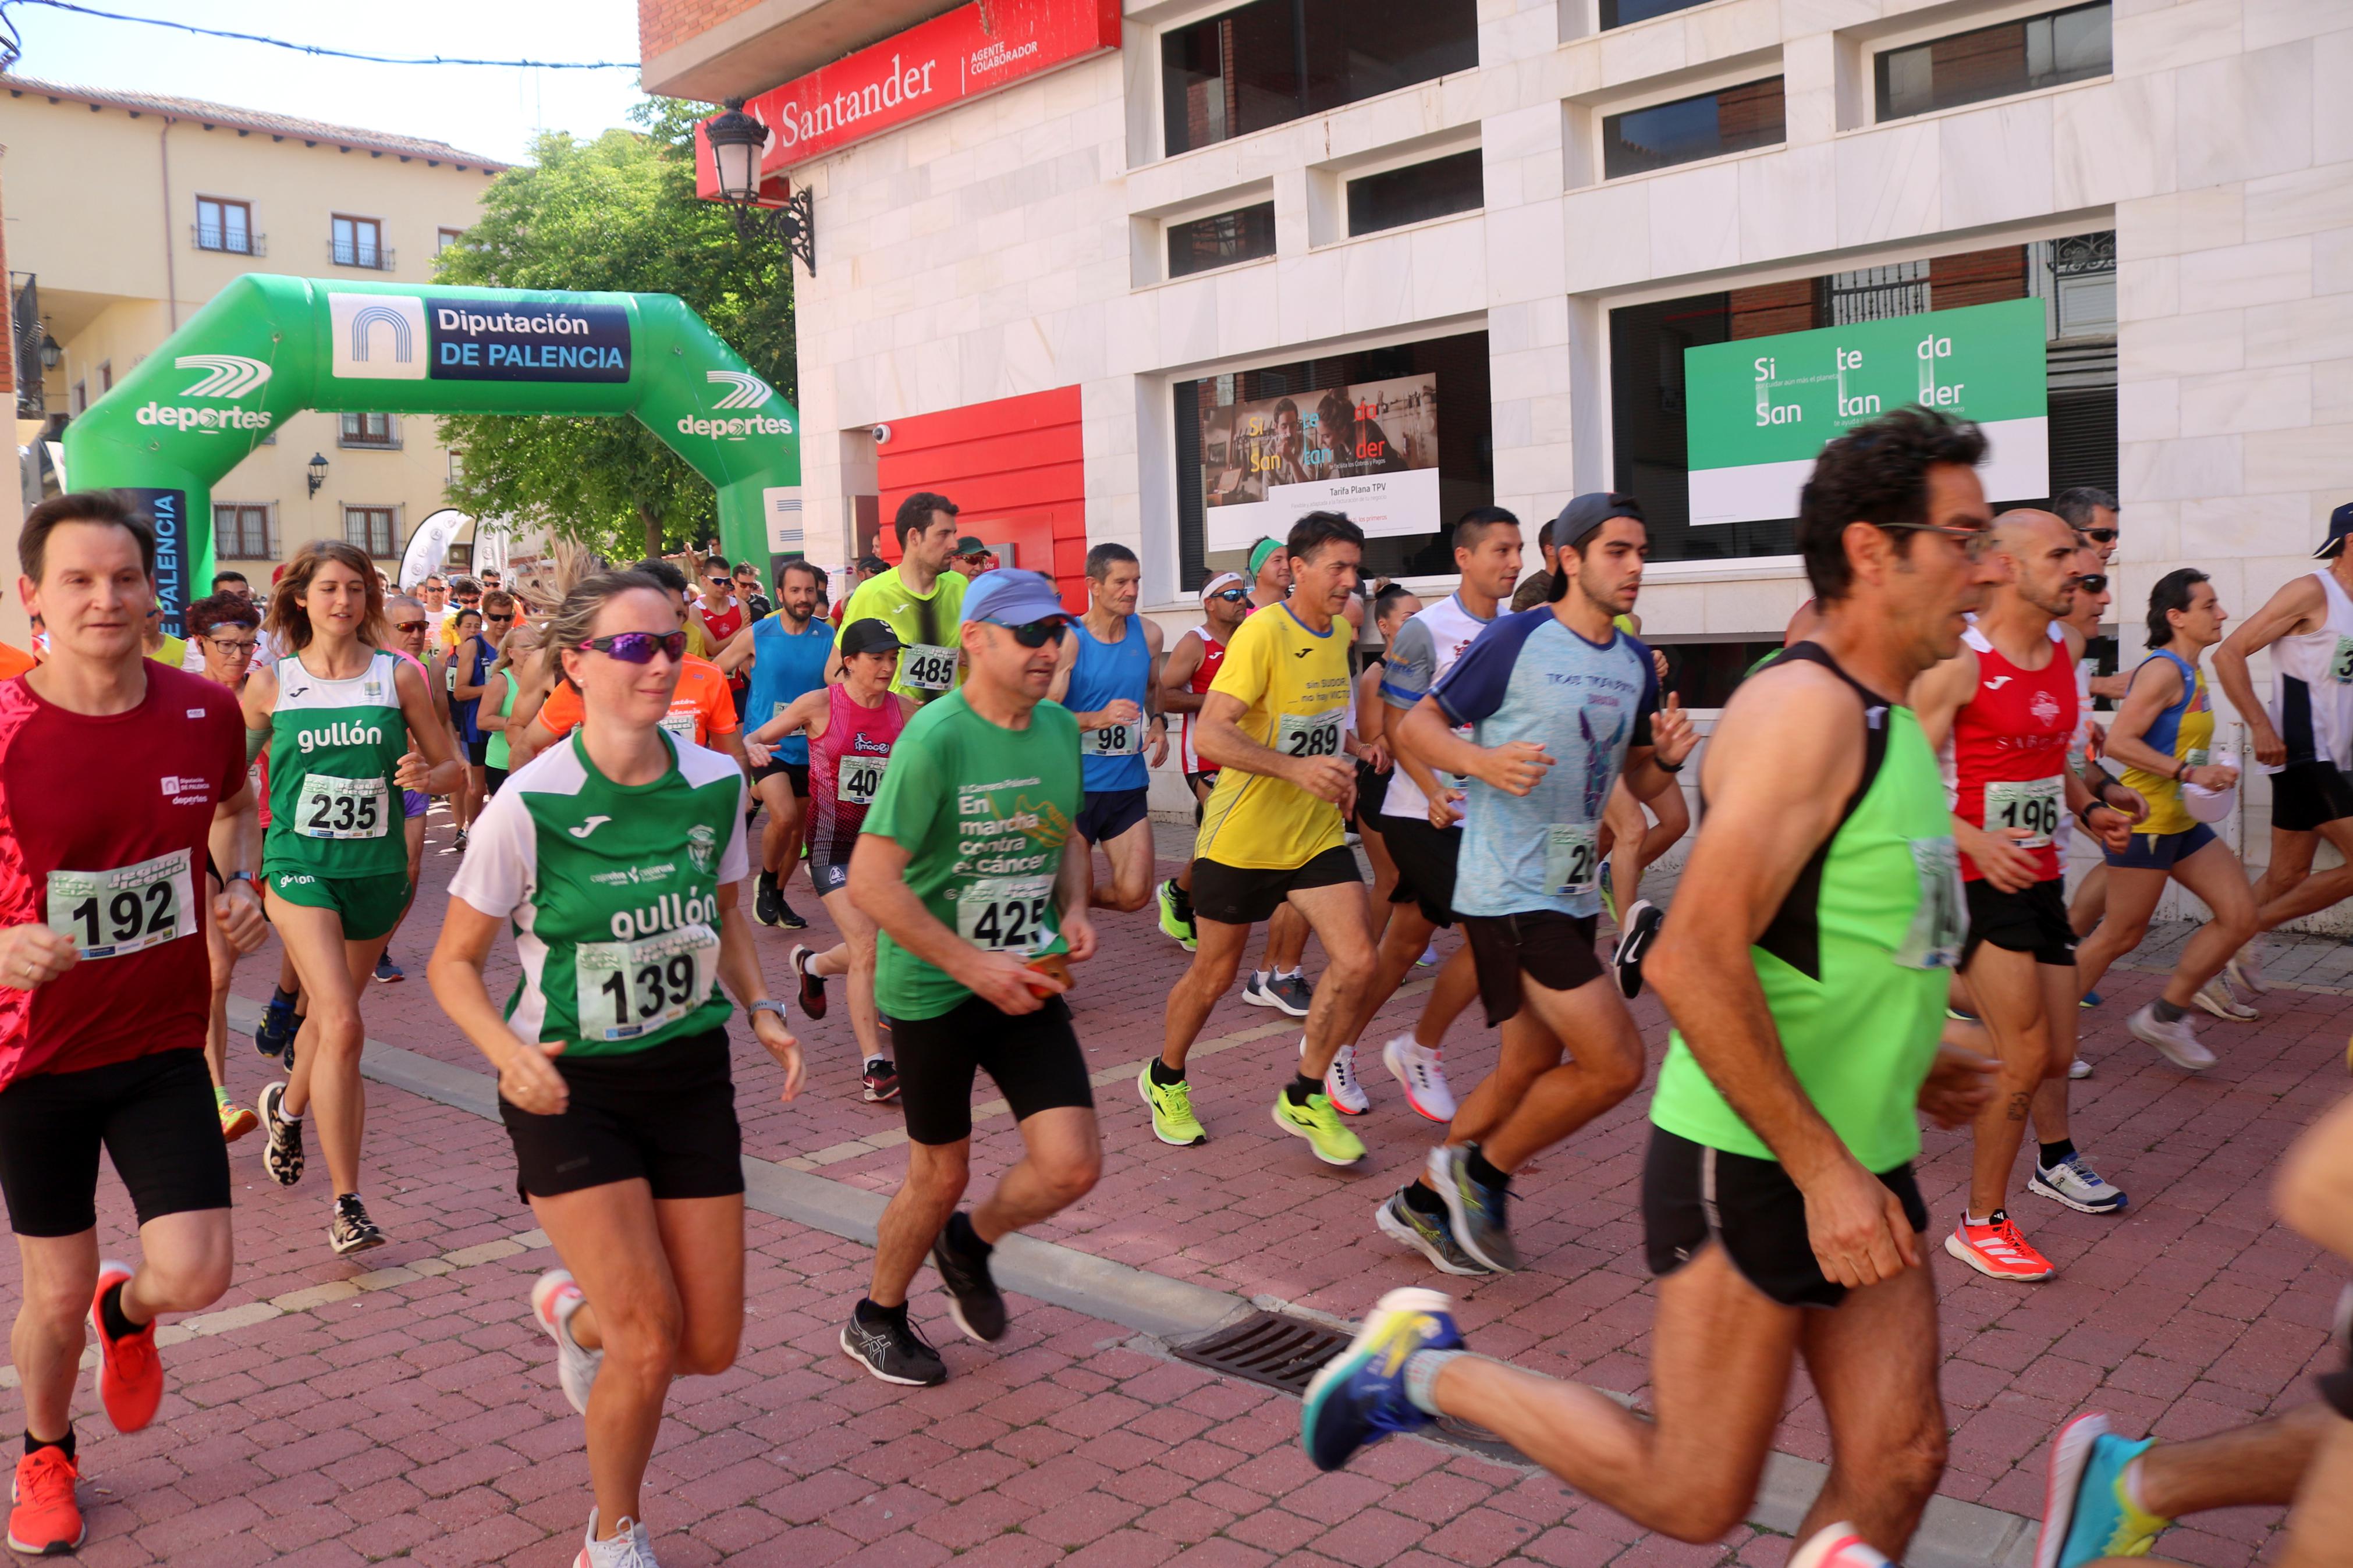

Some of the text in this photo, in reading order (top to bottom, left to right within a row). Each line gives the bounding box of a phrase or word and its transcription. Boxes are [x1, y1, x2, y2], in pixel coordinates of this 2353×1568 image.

[970, 41, 1005, 64] AGENTE
[970, 41, 1038, 76] COLABORADOR
[782, 53, 936, 148] Santander
[438, 308, 589, 336] Diputación
[441, 342, 624, 369] DE PALENCIA
[1754, 334, 1952, 382] Si te da
[1755, 382, 1765, 390] por
[1766, 379, 1783, 388] cuidar
[1817, 372, 1840, 382] planeta
[136, 401, 272, 434] deportes
[1249, 400, 1377, 436] Si te da
[1756, 382, 1964, 426] San tan der
[677, 414, 793, 440] deportes
[1841, 416, 1859, 426] ayuda
[1251, 438, 1386, 472] San tan der
[1330, 482, 1386, 496] Tarifa Plana TPV
[1371, 494, 1387, 502] negocio
[1367, 514, 1387, 524] primeros
[154, 495, 180, 617] PALENCIA
[910, 656, 953, 684] 485
[297, 720, 382, 753] gullón
[1098, 726, 1126, 749] 98
[1289, 724, 1337, 758] 289
[172, 795, 208, 805] deportes
[308, 794, 377, 830] 235
[958, 795, 989, 815] En
[959, 810, 1039, 836] marcha
[2000, 797, 2058, 835] 196
[958, 836, 1027, 855] contra
[975, 854, 1049, 874] cáncer
[72, 880, 176, 947] 192
[610, 885, 718, 943] gullón
[974, 898, 1045, 947] 425
[602, 954, 694, 1025] 139
